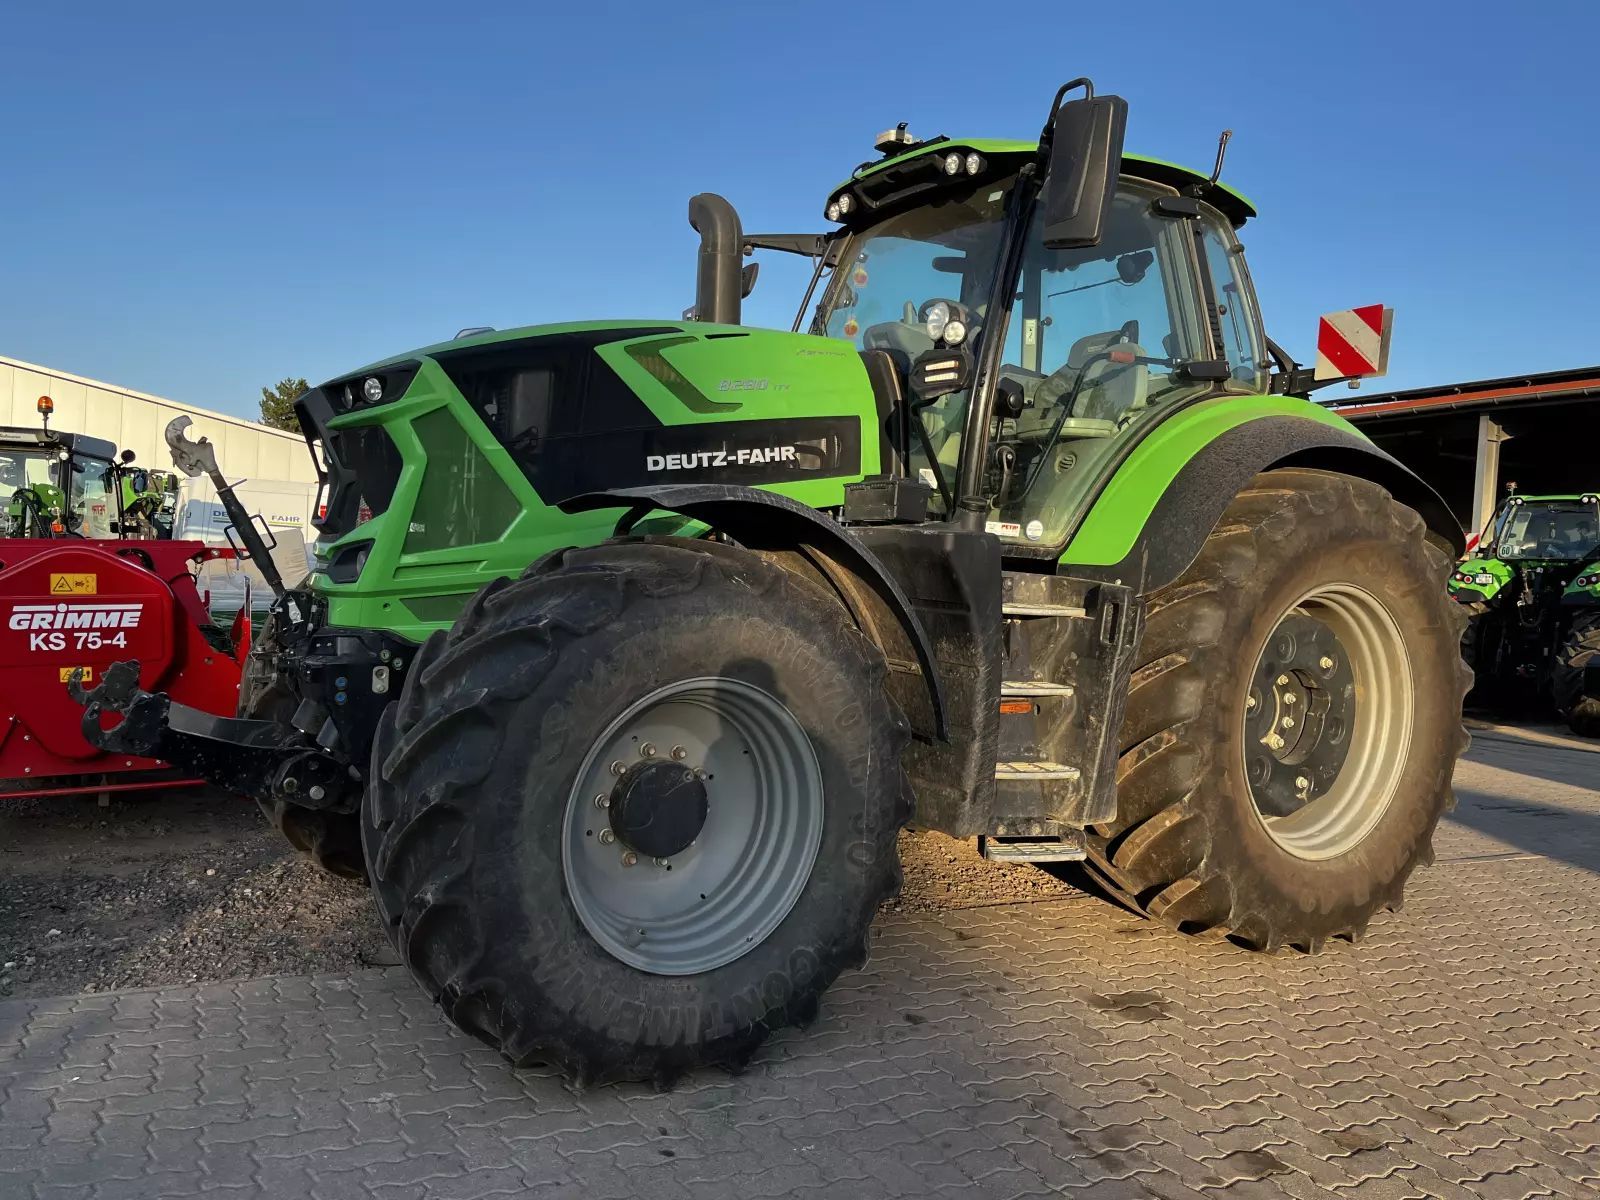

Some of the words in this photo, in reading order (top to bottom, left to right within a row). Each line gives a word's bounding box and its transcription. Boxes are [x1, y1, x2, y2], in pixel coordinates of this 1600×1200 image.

[646, 445, 797, 472] DEUTZ-FAHR
[271, 514, 301, 523] FAHR
[1501, 546, 1510, 555] 60
[8, 603, 142, 630] GRIMME
[29, 631, 67, 652] KS
[73, 631, 128, 650] 75-4
